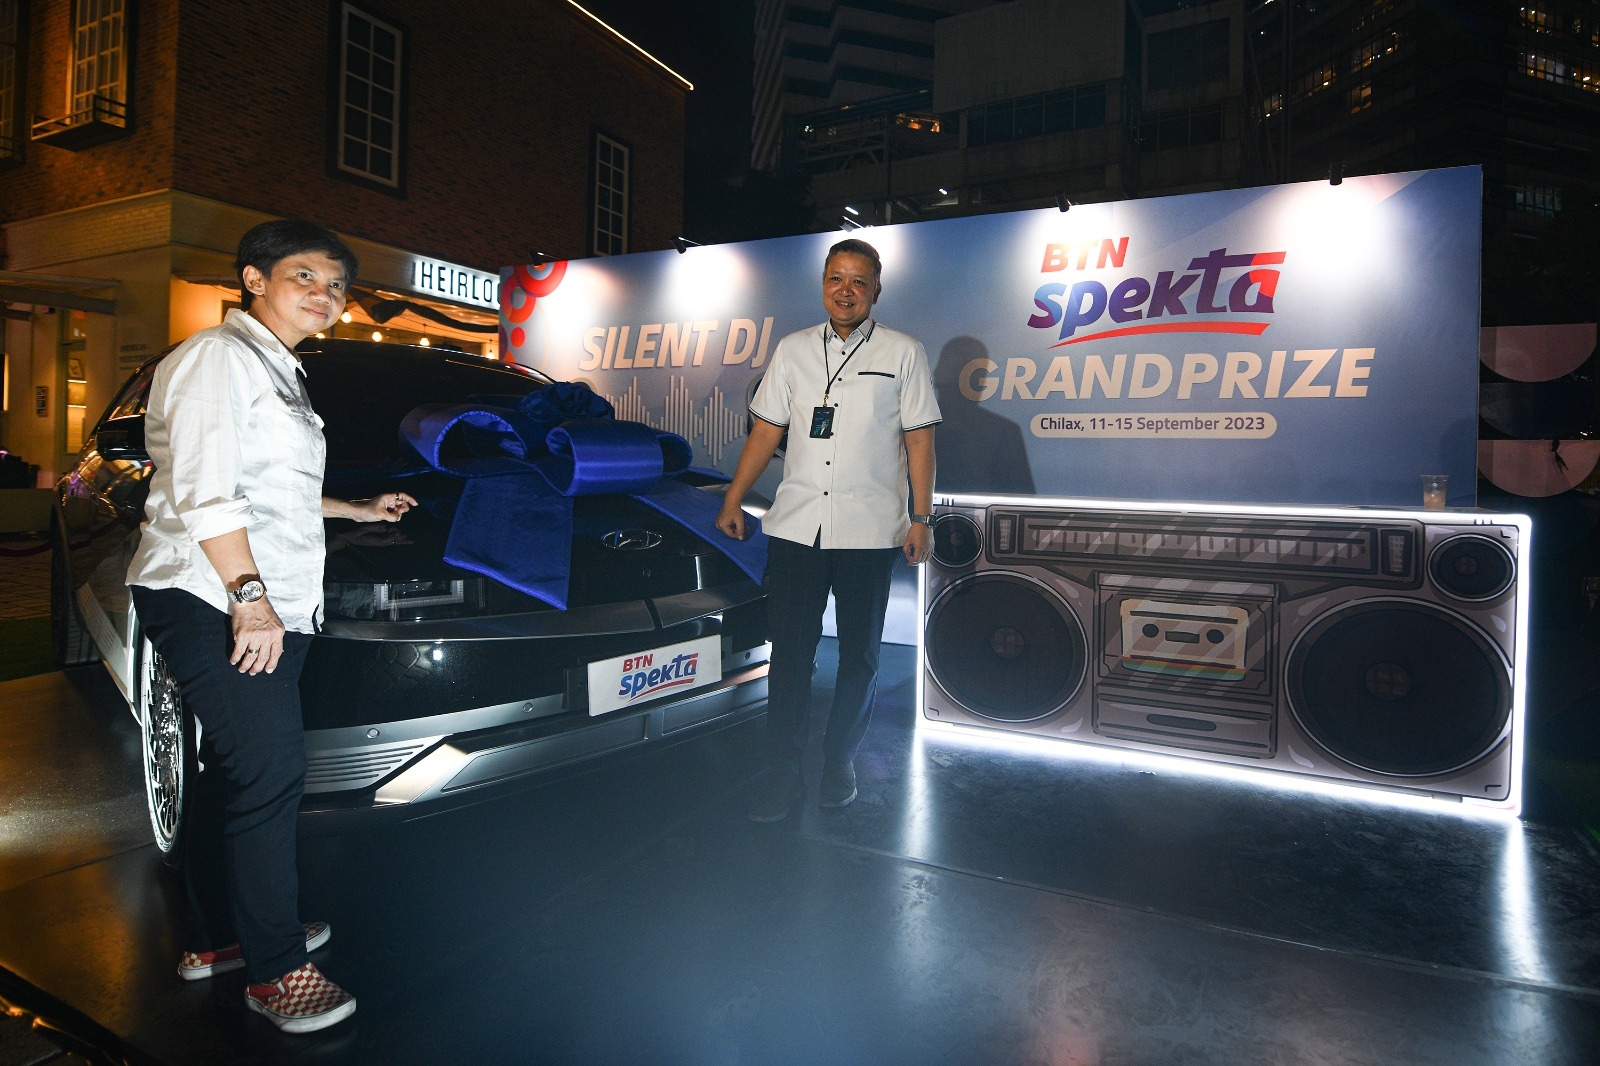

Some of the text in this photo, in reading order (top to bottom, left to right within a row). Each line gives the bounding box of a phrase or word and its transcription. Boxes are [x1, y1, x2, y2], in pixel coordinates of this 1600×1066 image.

[1041, 236, 1130, 273] BTN
[421, 261, 500, 305] HEIRLO
[578, 317, 774, 371] SILENT DJ
[1040, 416, 1265, 433] Chilax, 11-15 September 2023
[622, 653, 654, 673] BTN
